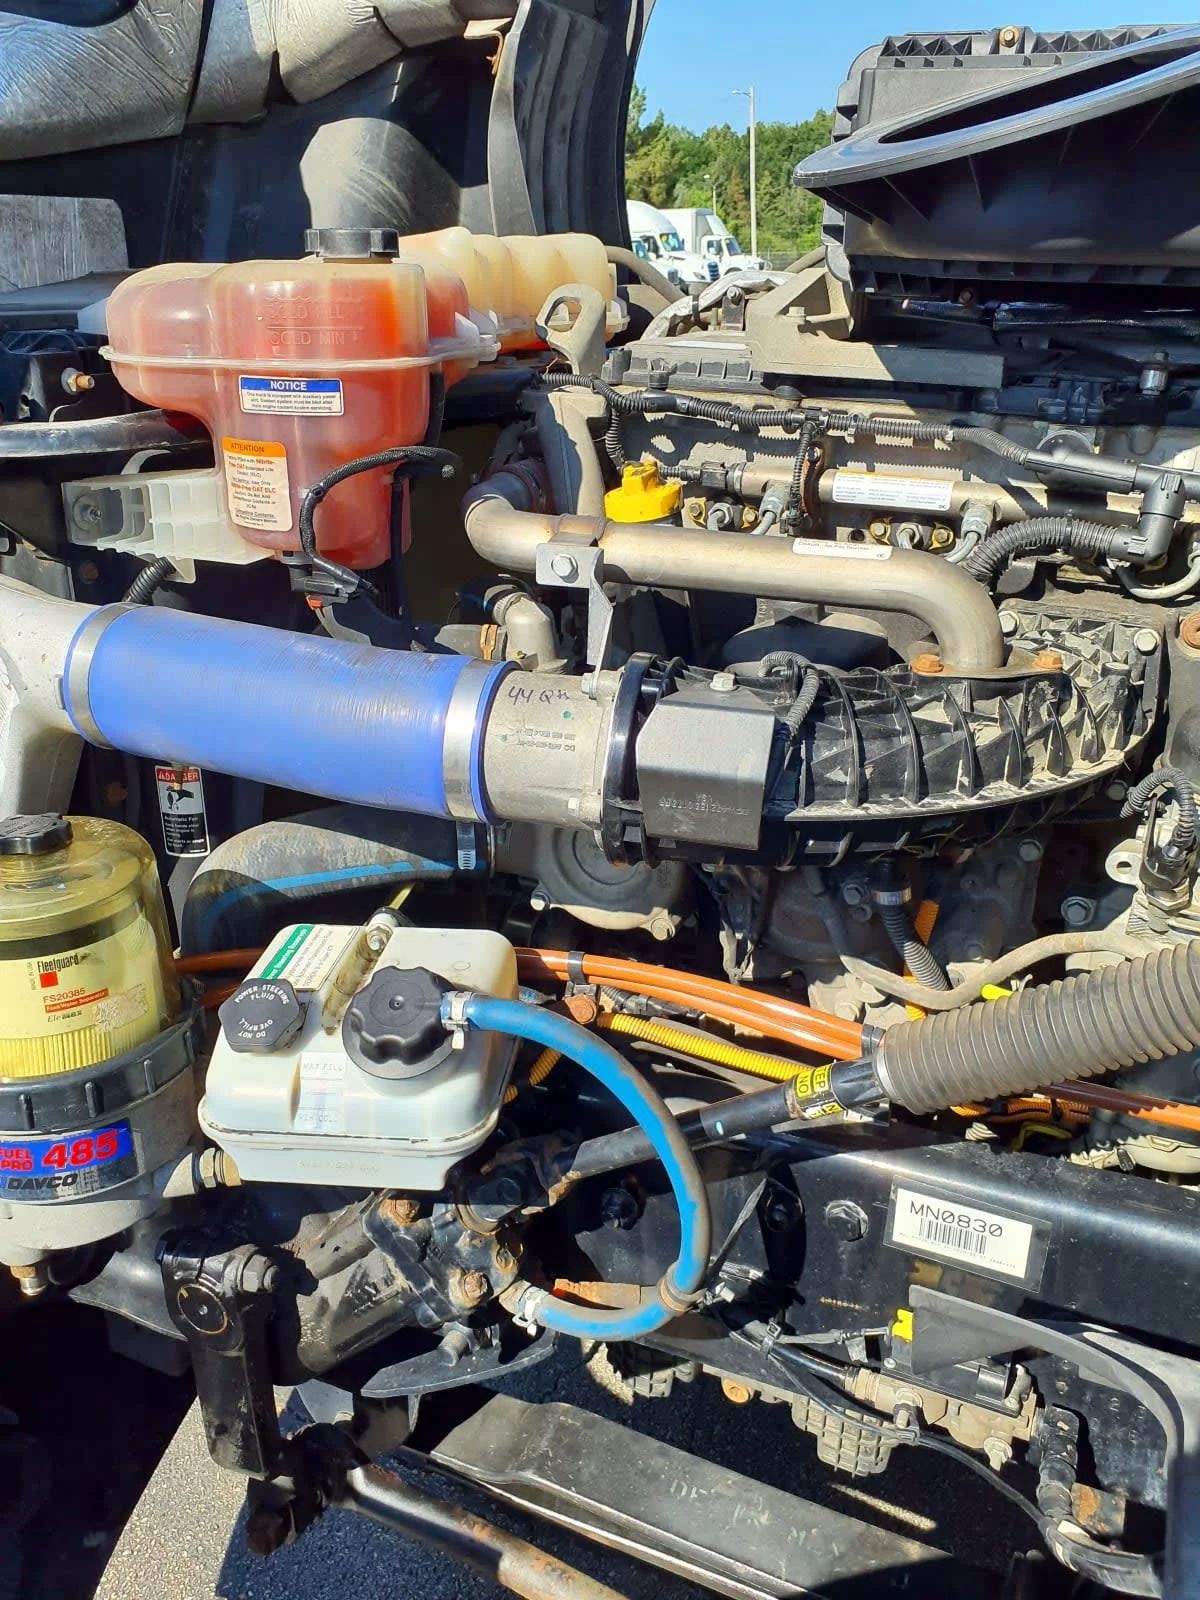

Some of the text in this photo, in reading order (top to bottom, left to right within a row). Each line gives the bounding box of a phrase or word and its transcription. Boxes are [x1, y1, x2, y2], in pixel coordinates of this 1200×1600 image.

[270, 380, 307, 391] NOTICE
[230, 442, 264, 453] ATTENTION
[508, 686, 534, 705] 44
[165, 771, 199, 781] DAGER
[37, 953, 80, 973] Fleetguard
[43, 987, 86, 1003] FS20385
[234, 985, 290, 1005] POWER STEERING
[250, 992, 275, 1001] FLUID
[239, 1018, 273, 1031] OVERFILL
[815, 1067, 827, 1088] TEP
[42, 1130, 118, 1169] 485
[1, 1161, 33, 1171] PRO
[8, 1173, 78, 1190] DAVCO
[910, 1200, 1003, 1237] MN0830
